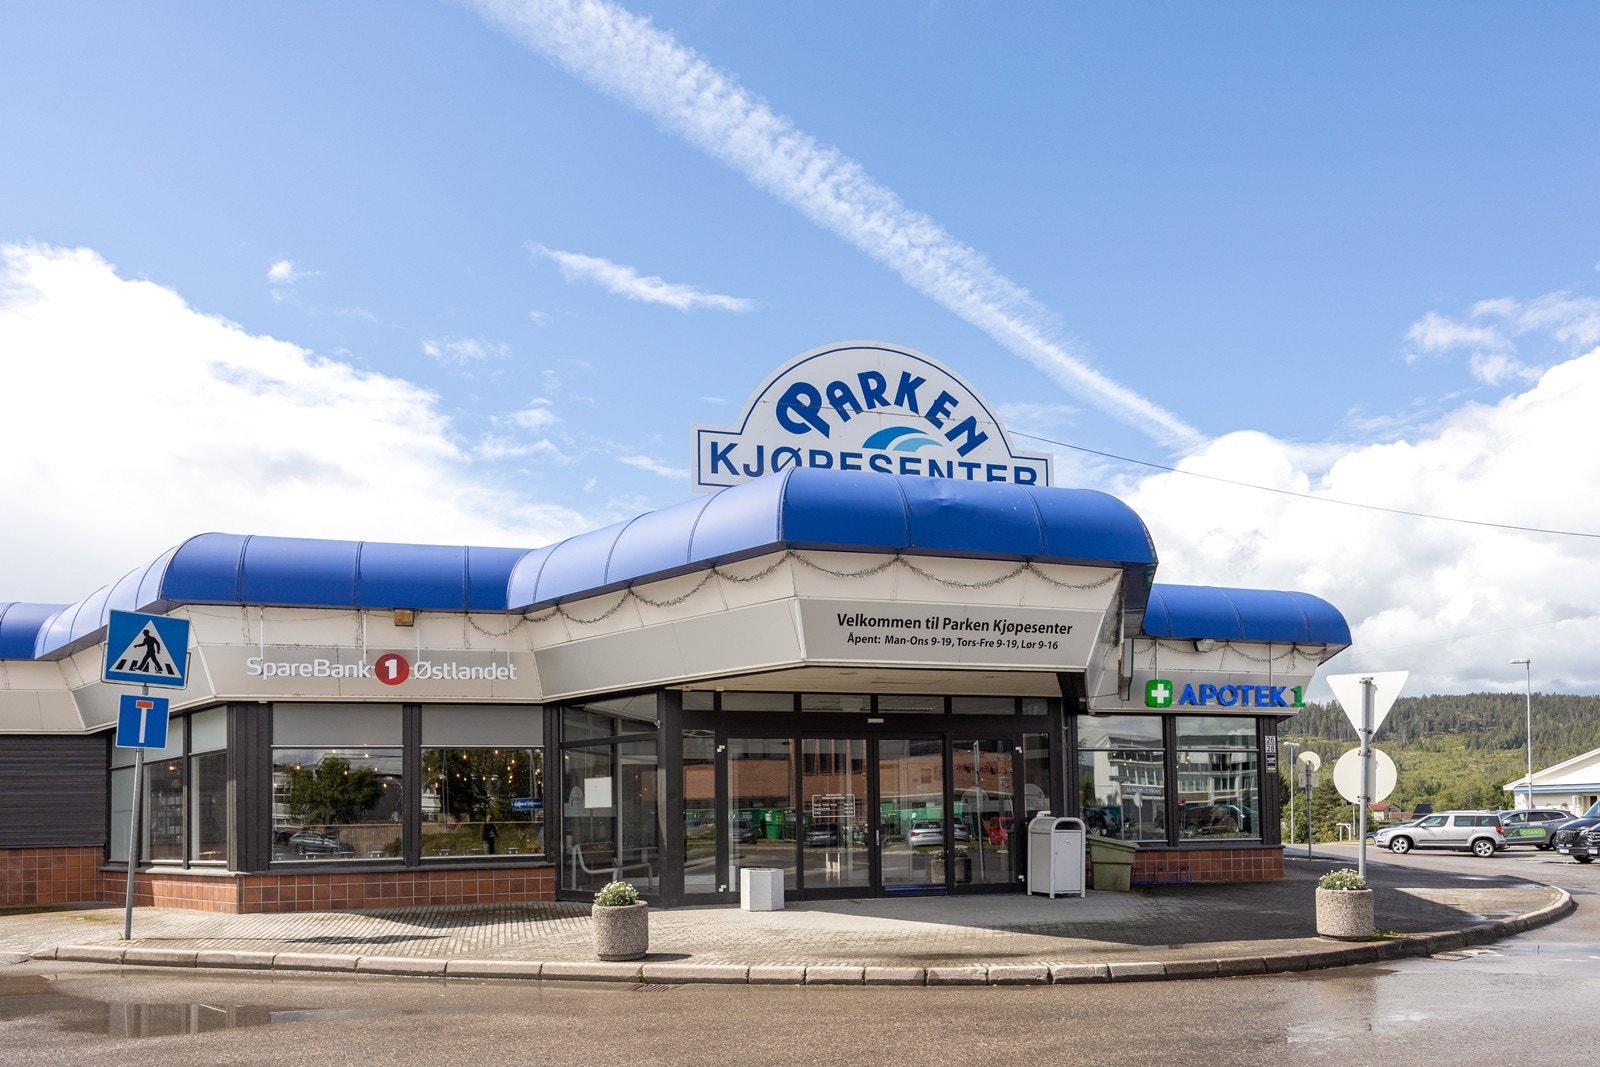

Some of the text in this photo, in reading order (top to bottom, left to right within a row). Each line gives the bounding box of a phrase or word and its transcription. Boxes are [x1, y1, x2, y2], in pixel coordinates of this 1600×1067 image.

[776, 370, 989, 457] PARKEN
[837, 613, 1073, 636] Velkommen til Parken Kjøpesenter
[847, 631, 1059, 650] Åpent: Man-Ons 9-19, Tors-Fre 9-19, Lør 9-16
[246, 657, 518, 681] SpareBank 1 Østlandet
[1178, 683, 1307, 708] APOTEK 1
[1266, 736, 1275, 744] 26
